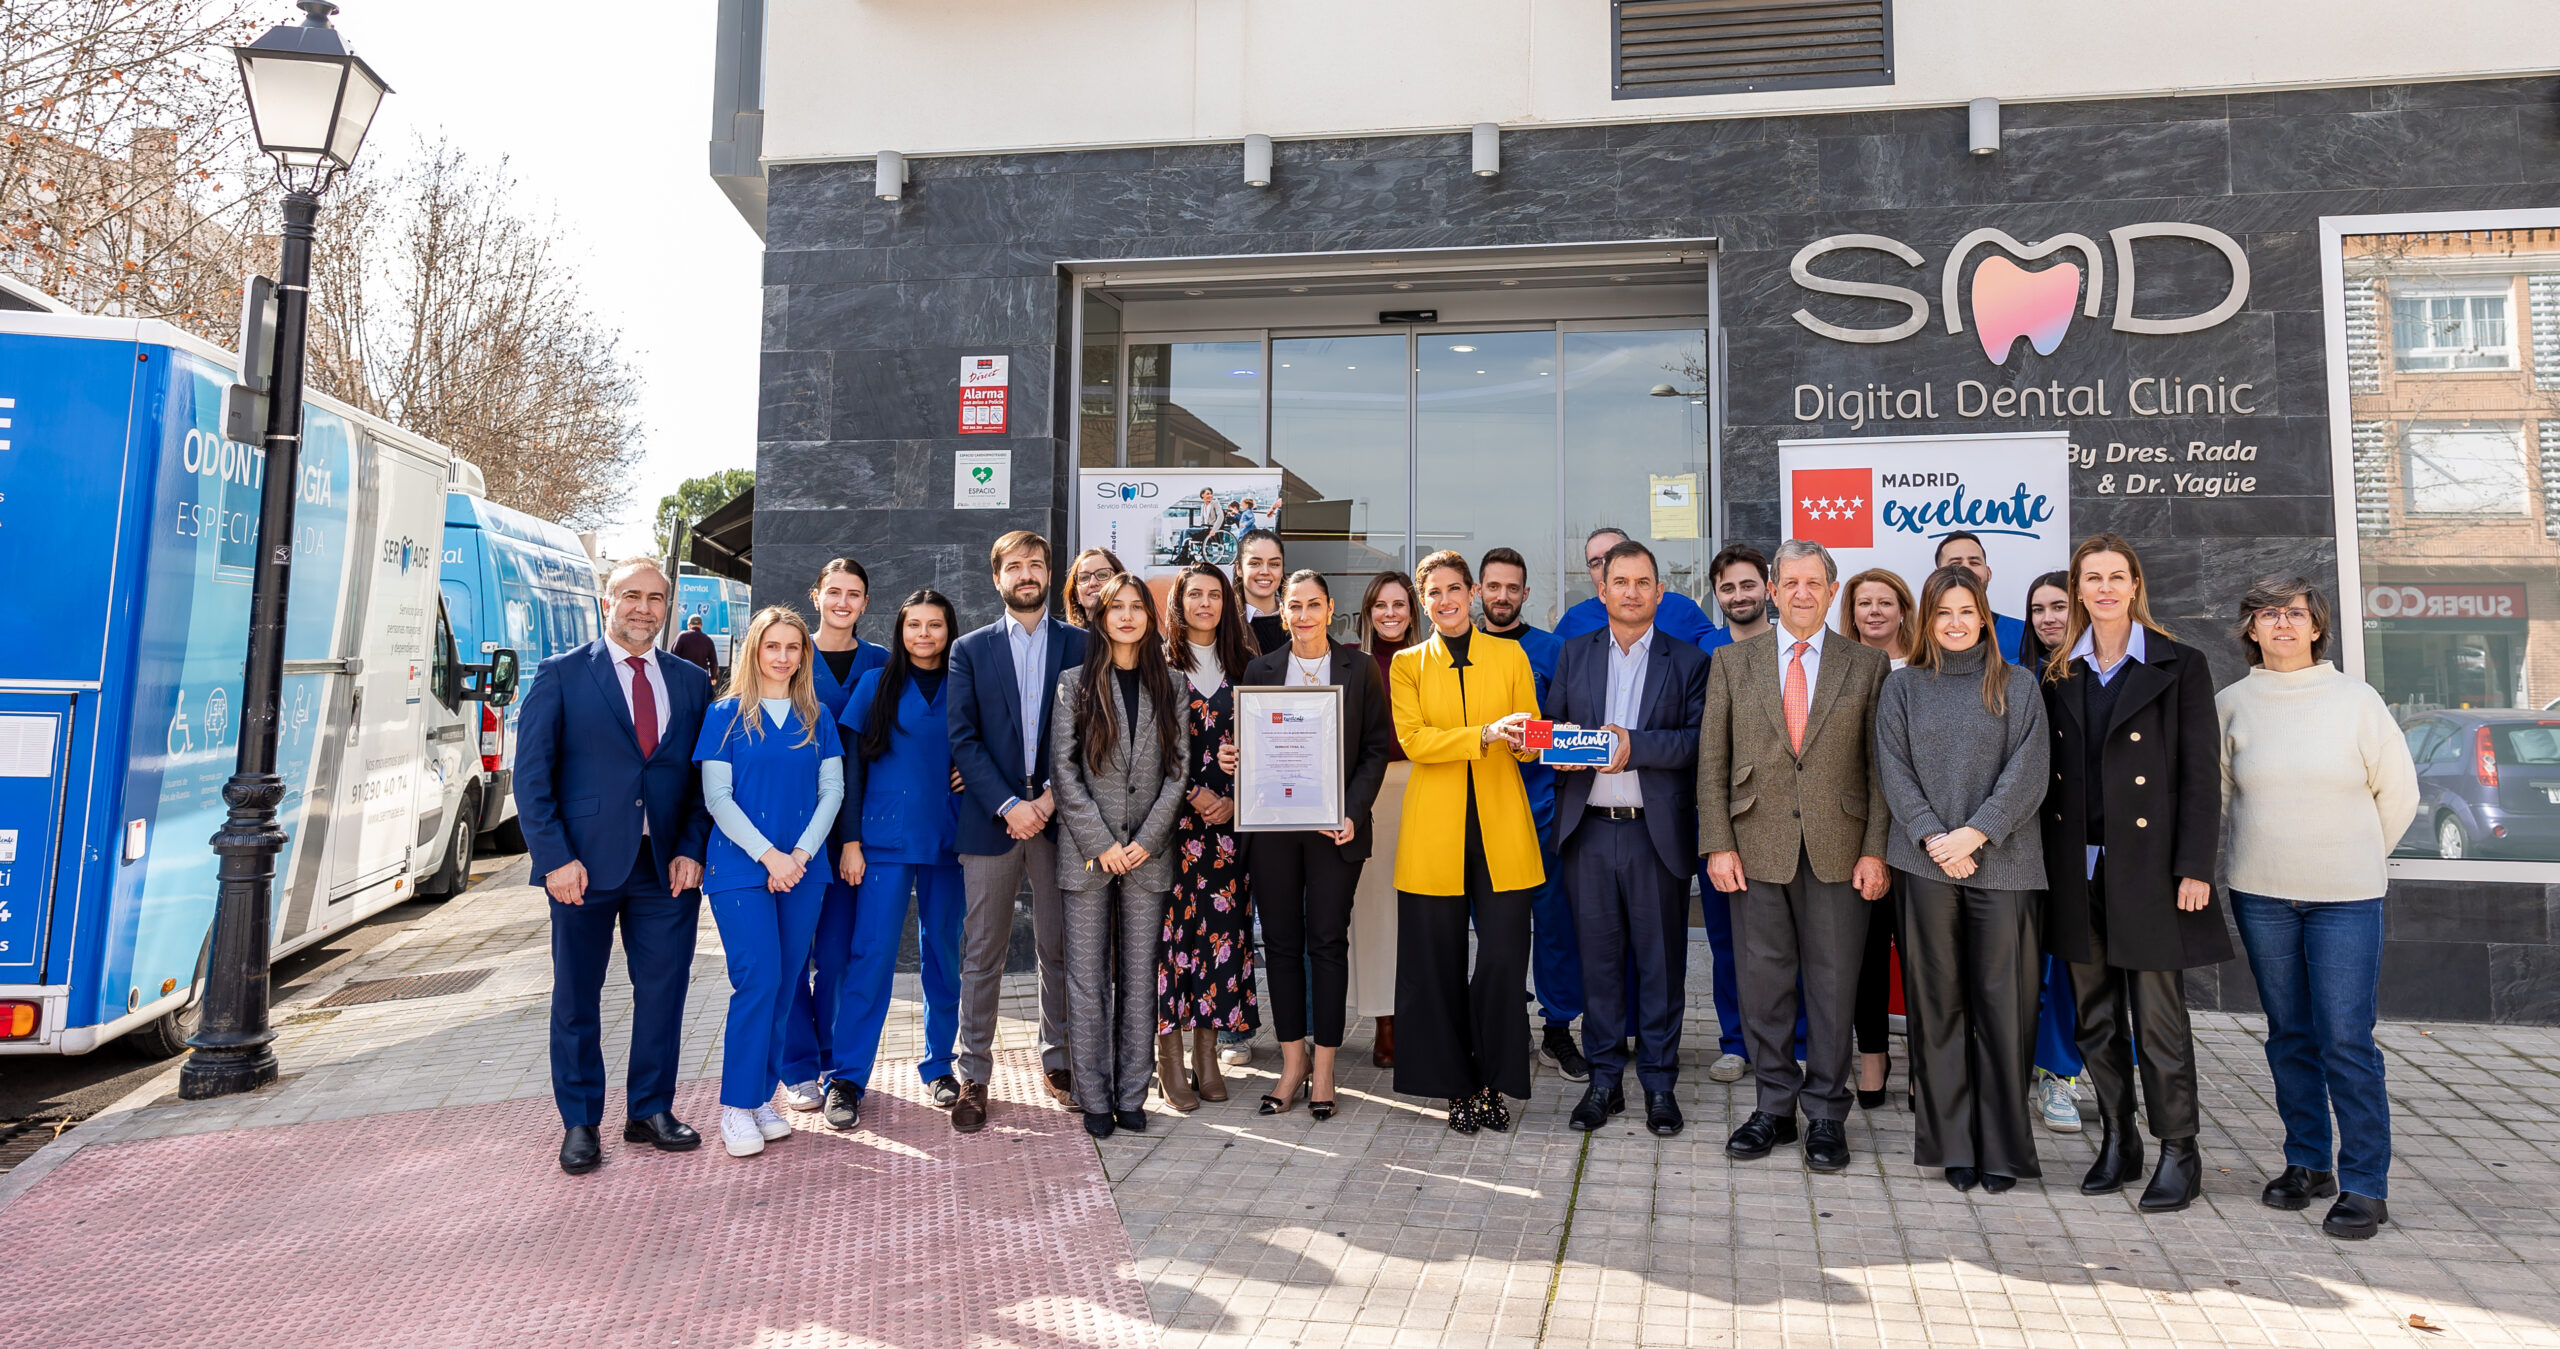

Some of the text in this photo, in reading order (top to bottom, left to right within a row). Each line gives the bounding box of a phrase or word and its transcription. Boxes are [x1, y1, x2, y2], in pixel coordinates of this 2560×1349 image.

[1790, 221, 2251, 343] SMD
[963, 388, 1004, 399] Alarma
[1793, 376, 2256, 431] Digital Dental Clinic
[2069, 440, 2258, 469] By Dres. Rada
[183, 428, 331, 508] ODONTOGÍA
[1882, 472, 1959, 488] MADRID
[968, 487, 996, 495] ESPACIO
[1097, 482, 1159, 498] SMD
[2097, 472, 2256, 498] & Dr. Yagüe
[1883, 482, 2054, 533] excelente
[176, 501, 325, 555] ESPECIAADA
[383, 536, 429, 569] SERMADE
[683, 584, 709, 593] Dental
[1553, 731, 1610, 750] excelente
[352, 783, 362, 805] 91
[363, 780, 381, 802] 290
